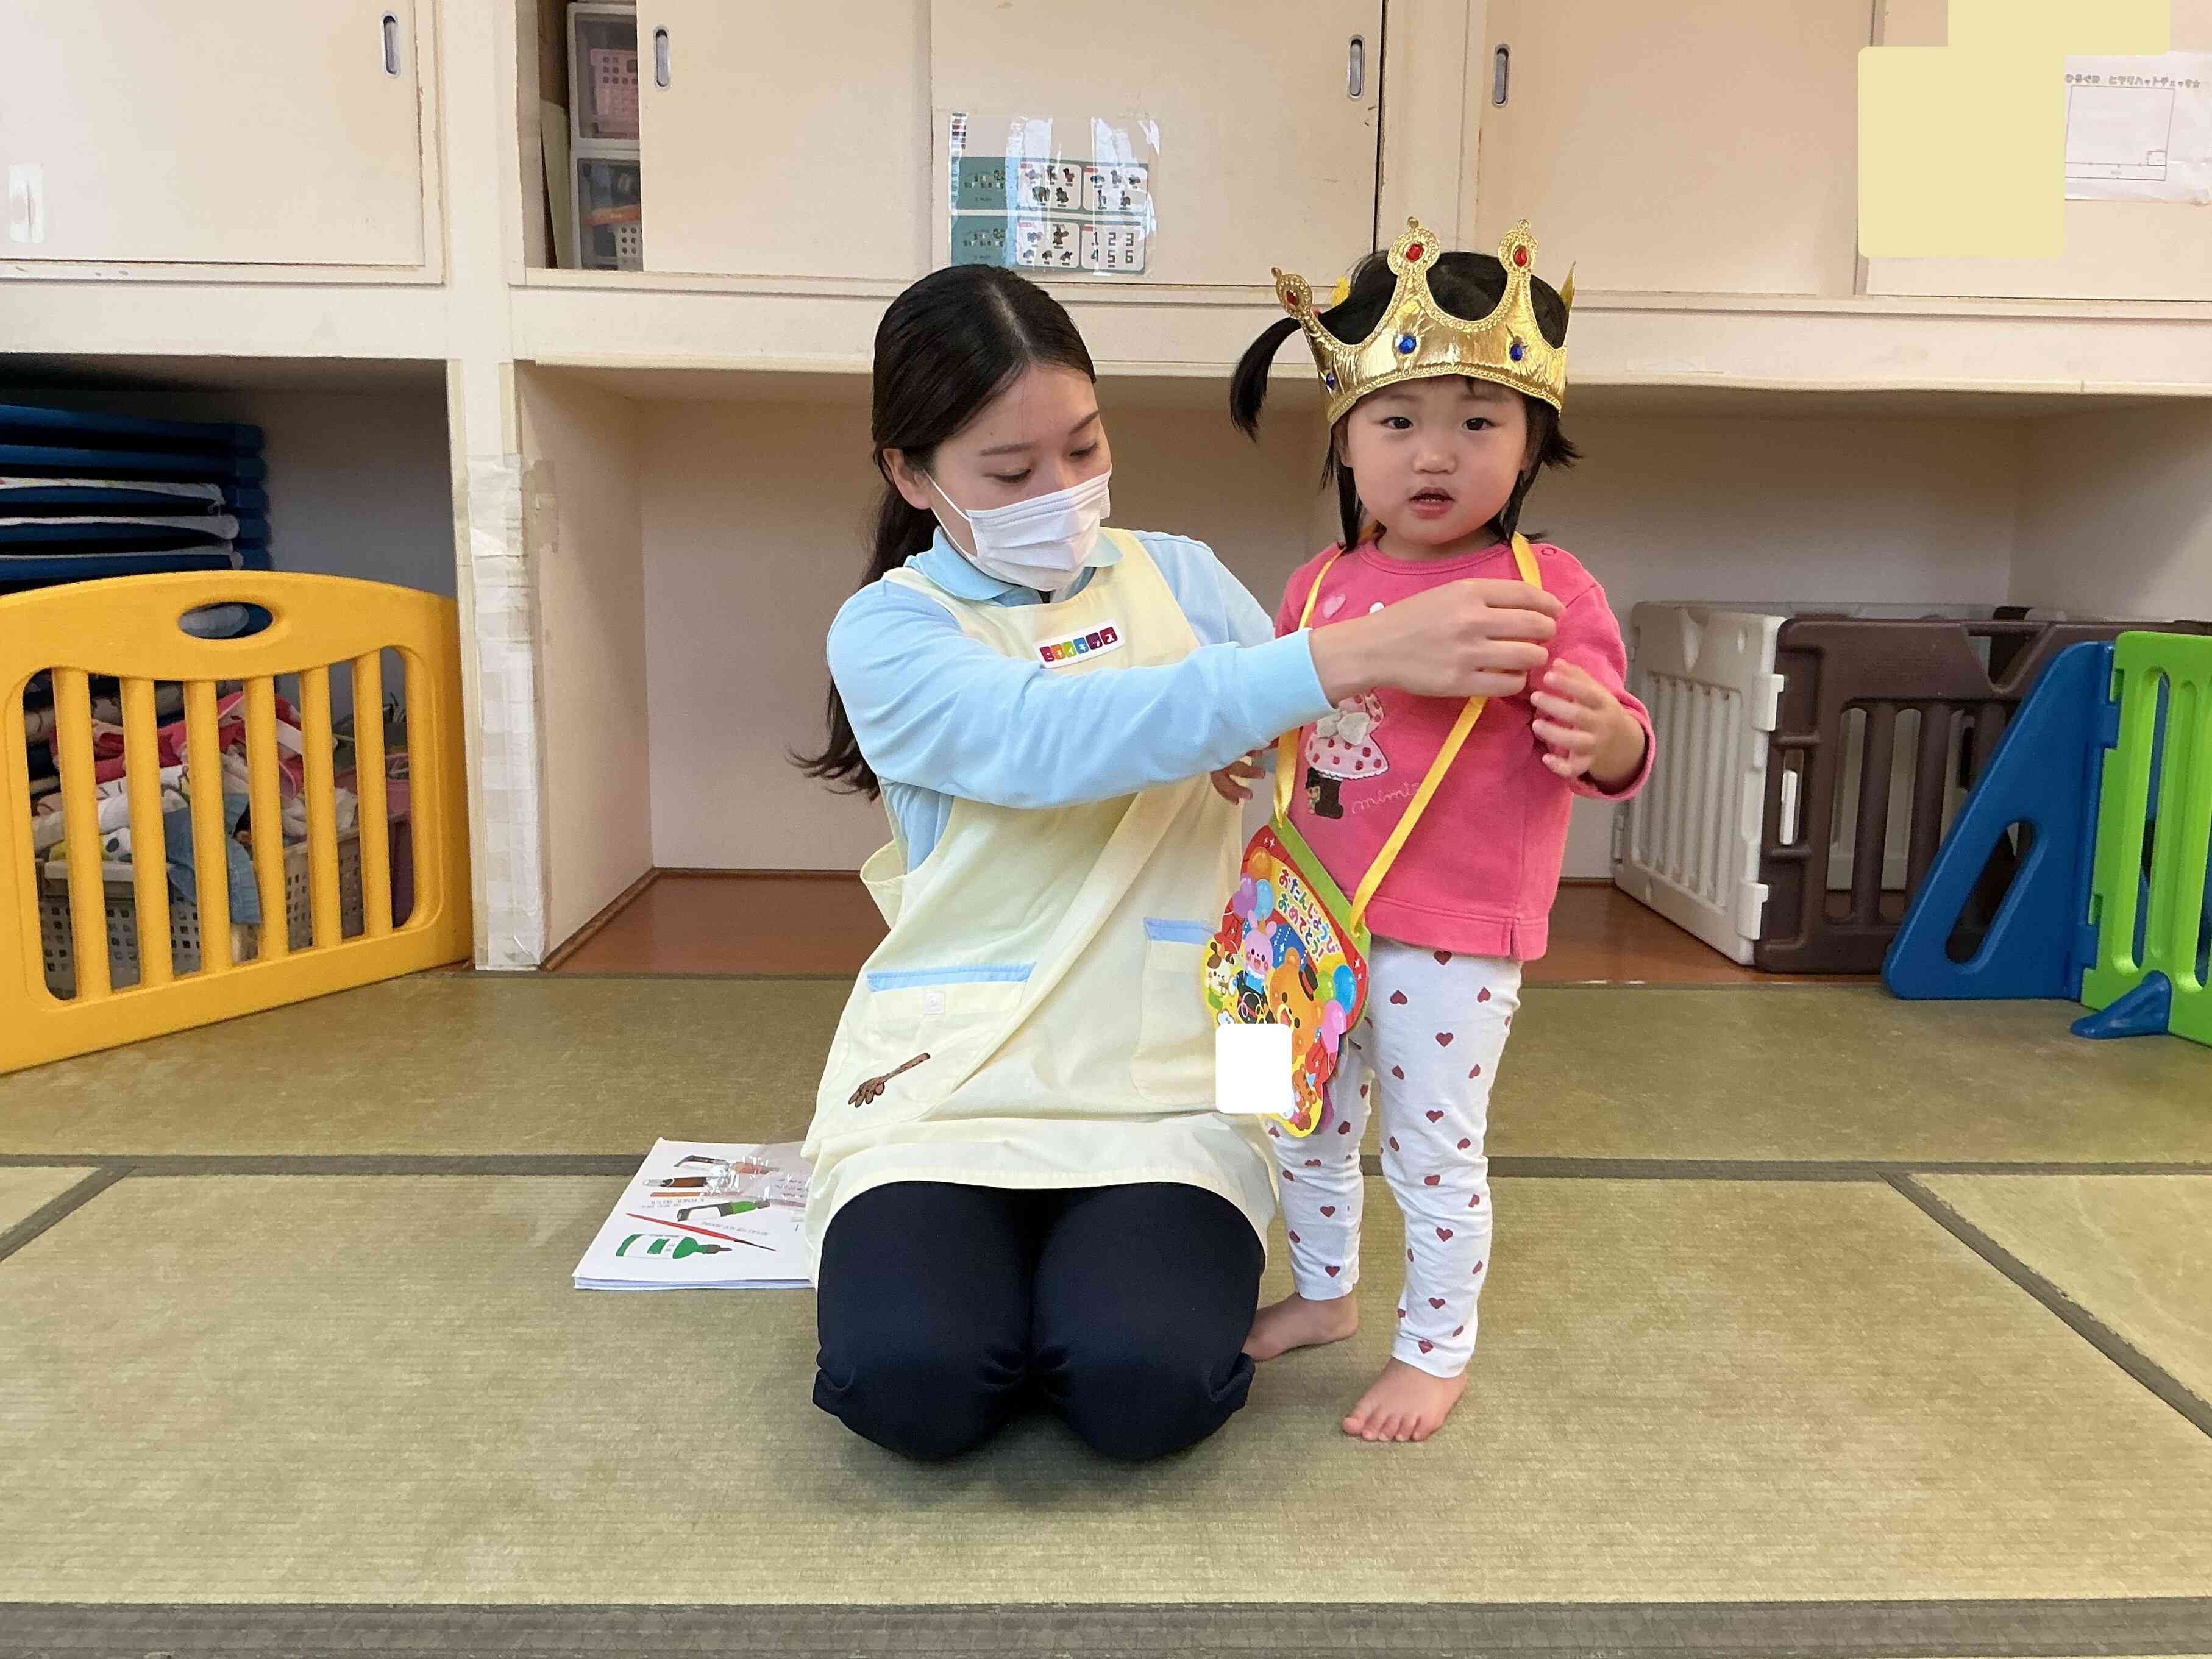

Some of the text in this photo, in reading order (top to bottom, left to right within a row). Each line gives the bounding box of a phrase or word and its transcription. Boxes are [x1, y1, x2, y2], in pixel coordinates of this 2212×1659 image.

[1091, 249, 1134, 264] 4 5 6
[1108, 232, 1117, 246] 2
[1126, 233, 1134, 246] 3
[1278, 893, 1325, 962] おめでとう!
[1279, 868, 1340, 953] おたんじょうび
